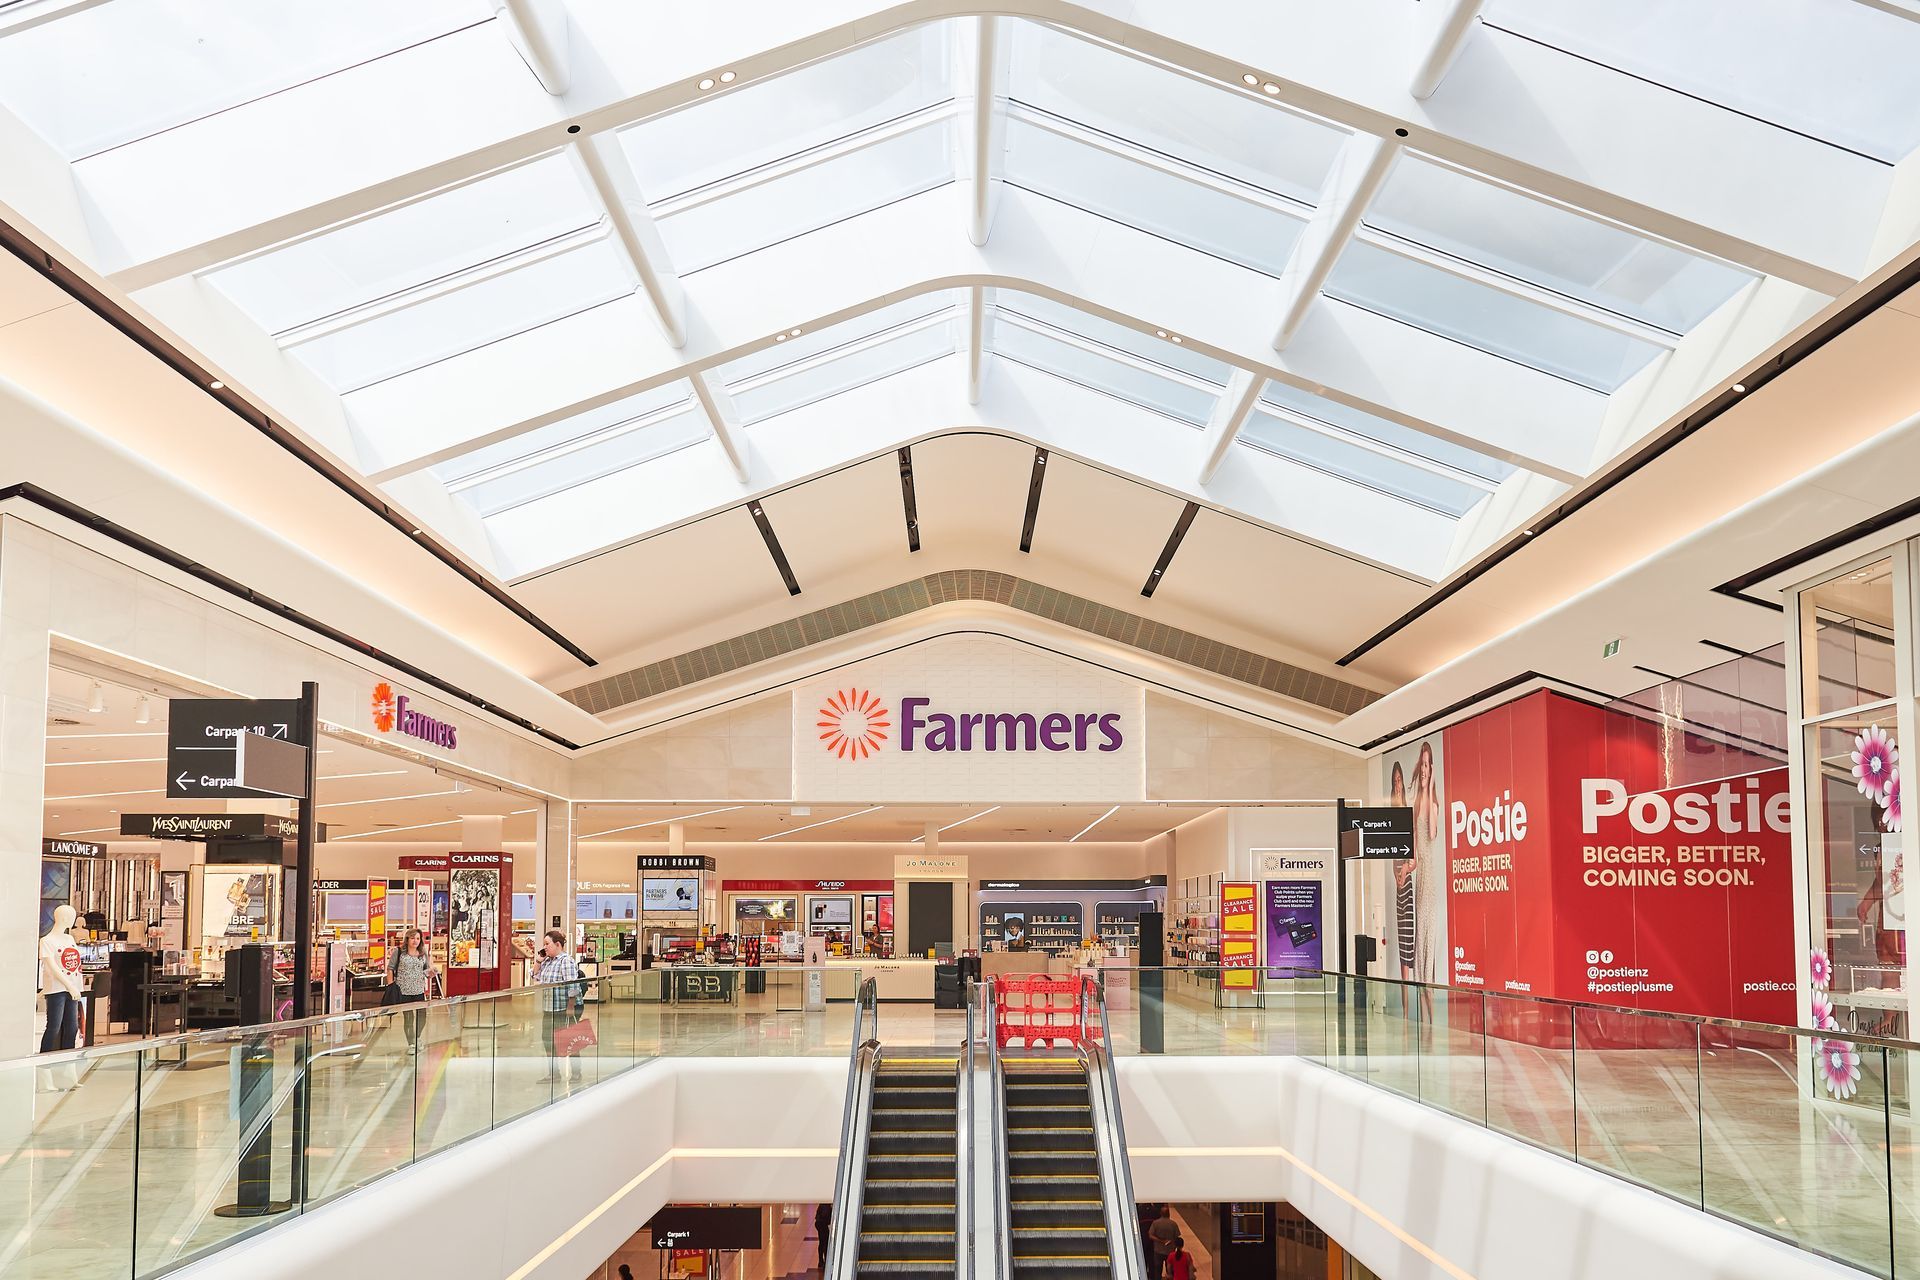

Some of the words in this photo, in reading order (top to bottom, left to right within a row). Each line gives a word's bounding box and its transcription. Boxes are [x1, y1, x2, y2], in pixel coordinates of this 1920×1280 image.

[396, 695, 457, 750] Farmers
[900, 697, 1123, 752] Farmers
[205, 725, 250, 739] Carpak
[252, 725, 266, 736] 10
[1580, 778, 1791, 834] Postie
[1363, 820, 1387, 828] Carpark
[1451, 789, 1527, 849] Postie
[51, 841, 91, 855] LANCÔME
[451, 855, 499, 863] CLARINS
[642, 858, 667, 866] BOBBI
[672, 858, 700, 866] BROWN
[1583, 846, 1671, 866] BIGGER,
[1677, 846, 1766, 866] BETTER,
[1280, 857, 1324, 869] Farmers
[1453, 857, 1482, 874] BIGGER,
[1482, 853, 1512, 872] BETTER,
[1583, 869, 1677, 887] COMING
[1683, 868, 1754, 886] SOON.
[312, 881, 339, 889] AUDER
[1453, 876, 1484, 893] COMING
[1485, 875, 1509, 892] SOON.
[1223, 899, 1253, 907] CLEARANCE
[1224, 904, 1254, 914] SALE
[370, 905, 386, 915] SALE
[229, 915, 254, 925] IBRE
[1223, 953, 1253, 962] CLEARANCE
[1224, 958, 1254, 968] SALE
[1587, 967, 1648, 979] @postienz
[686, 975, 720, 993] BB
[1587, 982, 1673, 994] #postieplusme
[1743, 980, 1796, 994] postie.co
[676, 1249, 704, 1257] SALE
